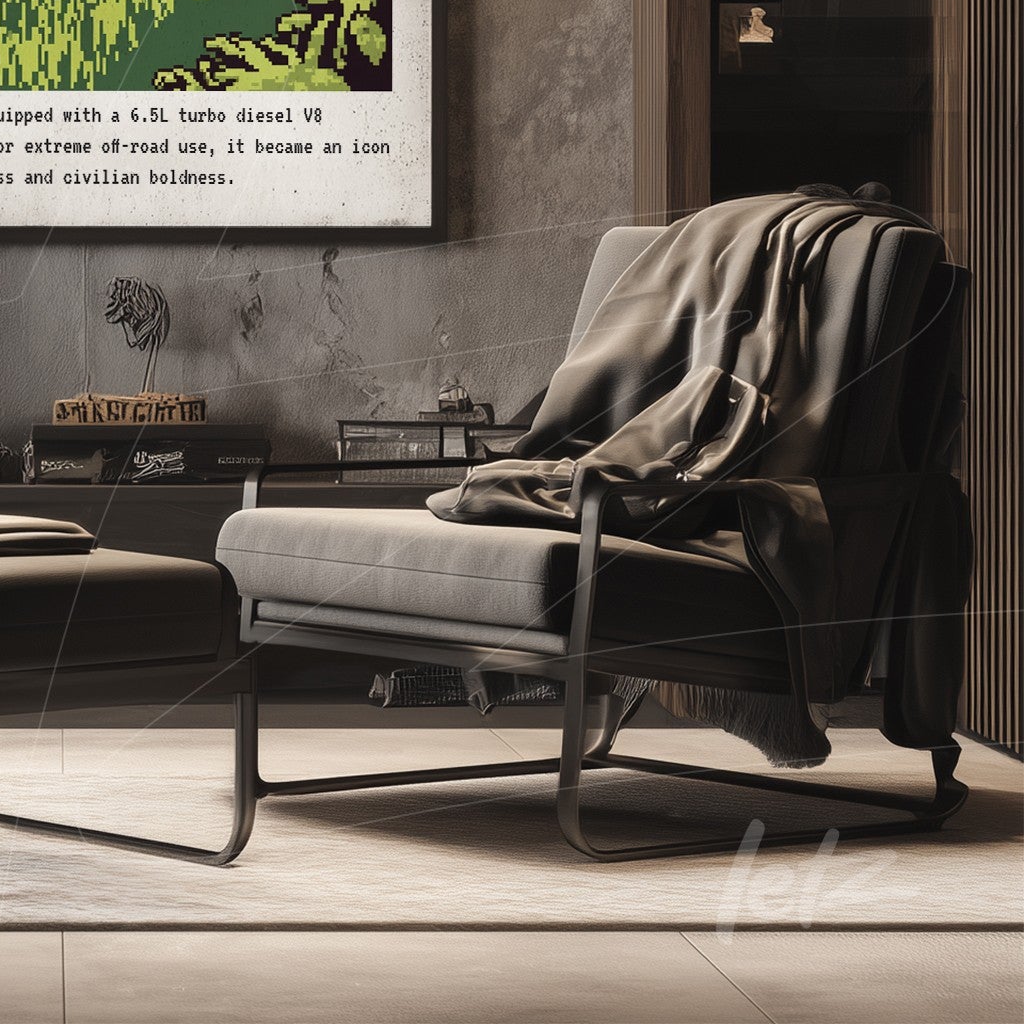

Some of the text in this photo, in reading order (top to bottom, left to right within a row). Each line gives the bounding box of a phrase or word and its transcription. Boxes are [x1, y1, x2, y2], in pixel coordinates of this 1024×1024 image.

[63, 107, 101, 123] with
[111, 111, 120, 123] a
[130, 107, 169, 123] 6.5L
[178, 107, 226, 123] turbo
[236, 107, 293, 123] diesel
[303, 107, 322, 123] V8
[24, 138, 92, 154] extreme
[101, 138, 169, 154] off-road
[178, 142, 216, 158] use,
[227, 138, 244, 154] it
[255, 138, 313, 154] became
[323, 142, 342, 154] an
[352, 138, 390, 154] icon
[24, 169, 53, 185] and
[63, 169, 140, 185] civilian
[149, 169, 236, 185] boldness.
